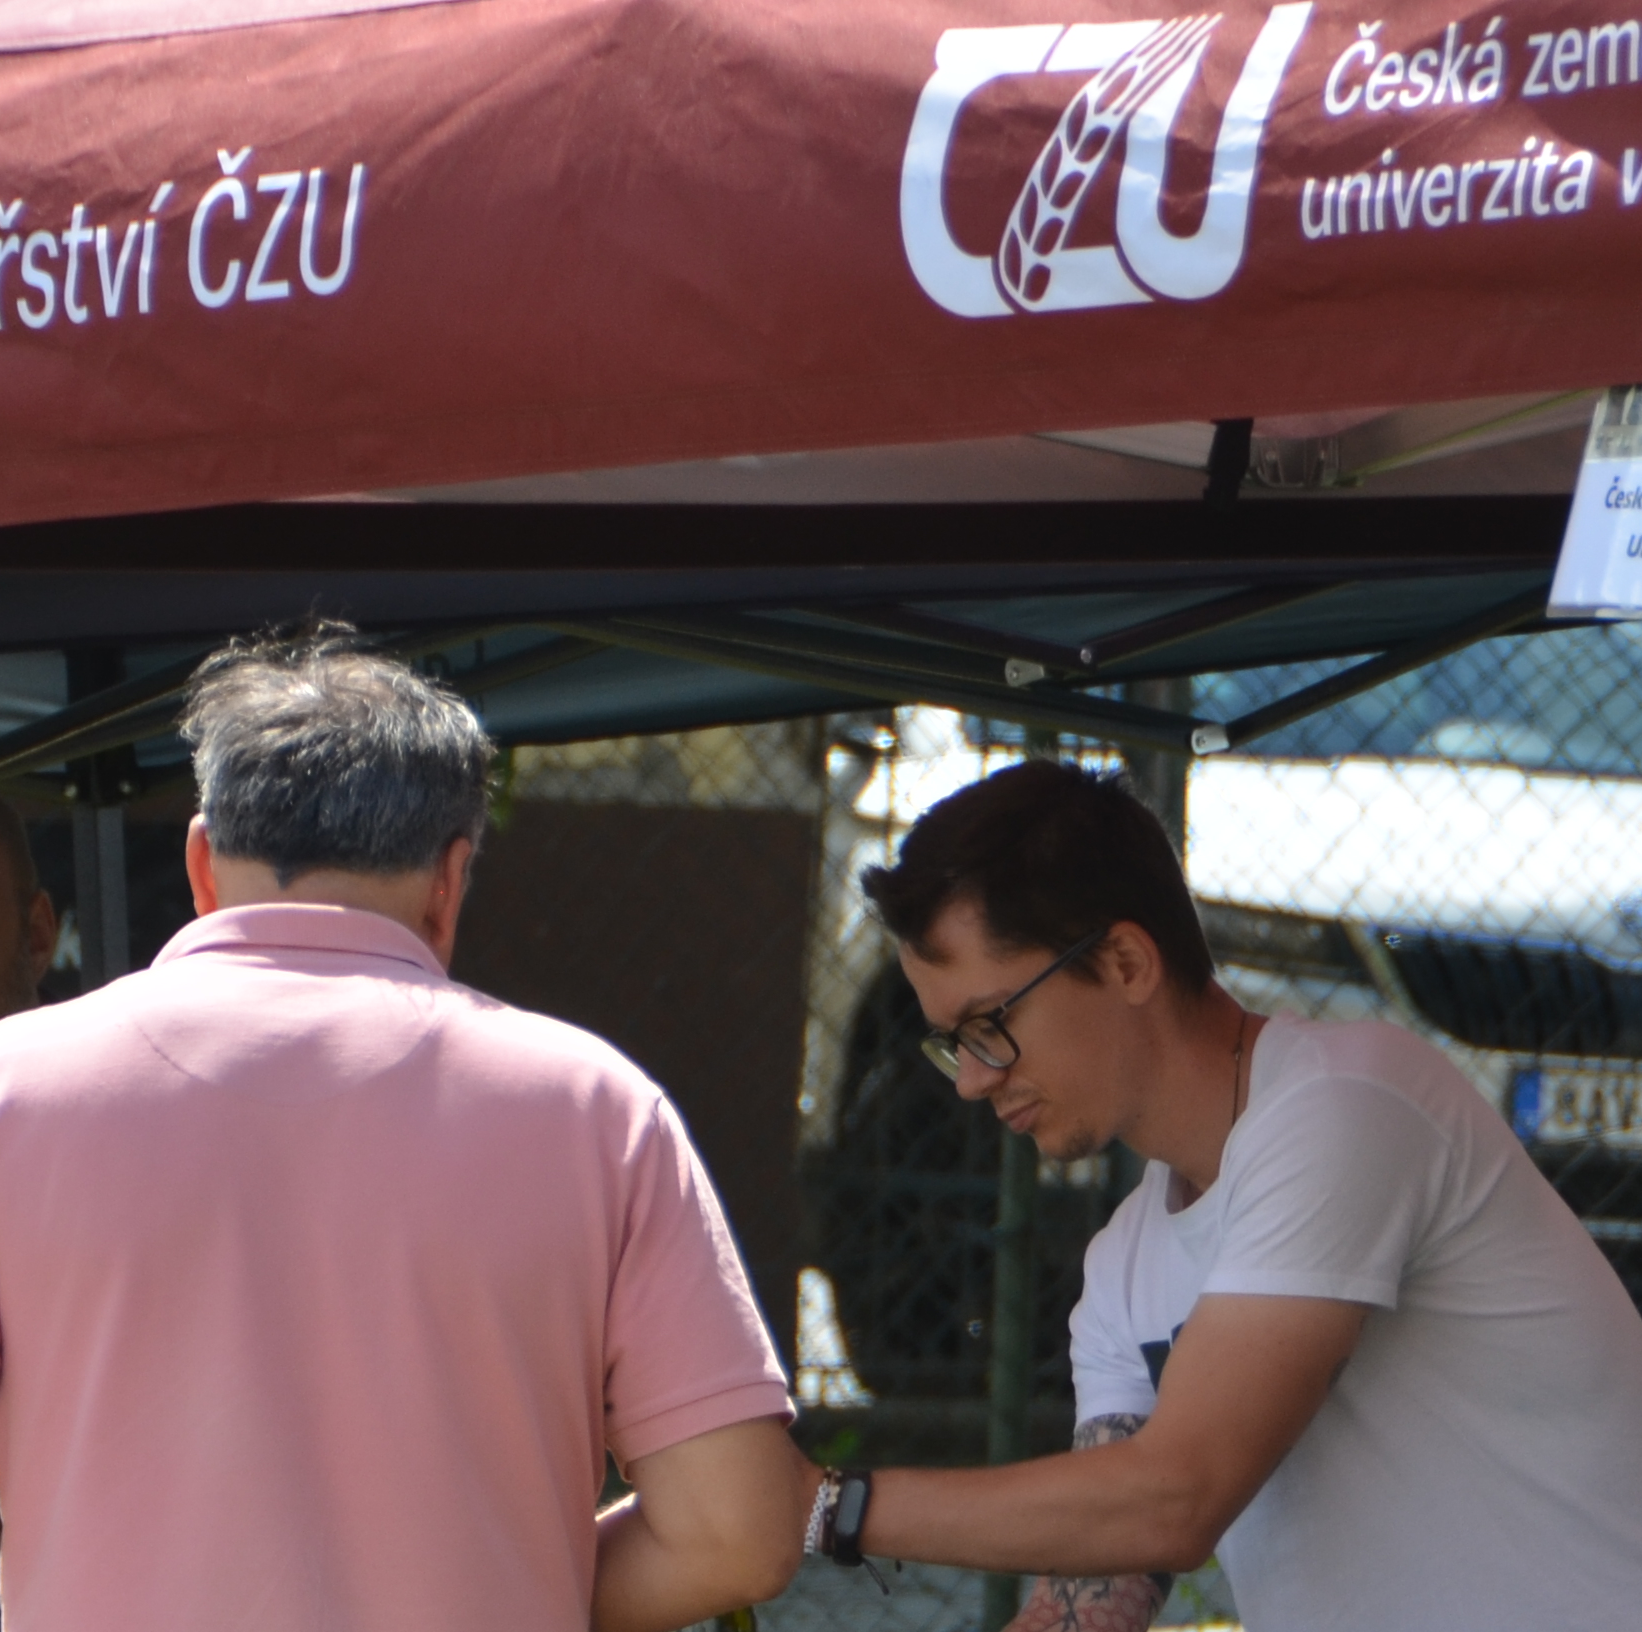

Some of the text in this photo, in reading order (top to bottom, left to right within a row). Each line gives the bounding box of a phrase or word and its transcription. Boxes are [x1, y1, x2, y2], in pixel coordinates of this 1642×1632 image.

[1324, 15, 1504, 115] Česká
[188, 147, 365, 309] ČZU
[1301, 136, 1593, 239] univerzita
